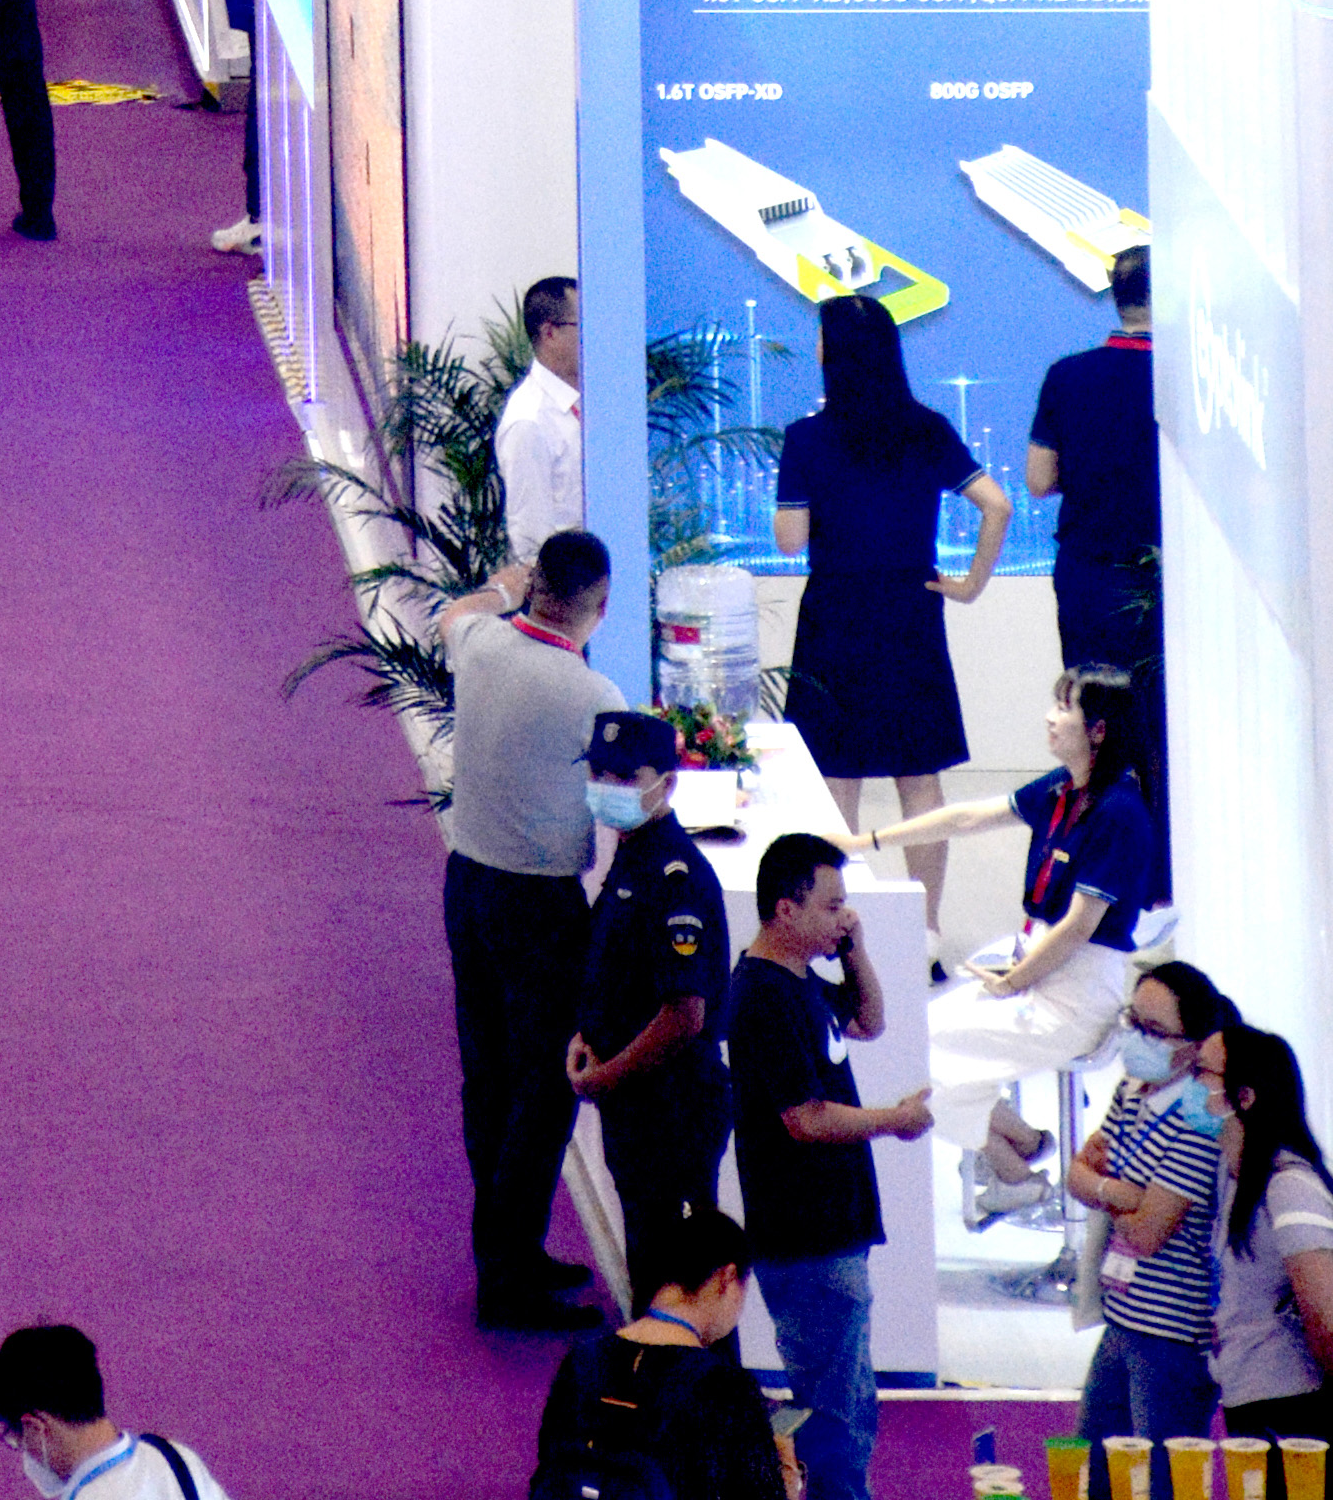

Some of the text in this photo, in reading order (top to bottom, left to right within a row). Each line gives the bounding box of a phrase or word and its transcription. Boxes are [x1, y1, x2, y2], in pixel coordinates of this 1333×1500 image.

[656, 83, 783, 101] 1.6T OSFP-XD
[930, 81, 1035, 100] 800G OSFP
